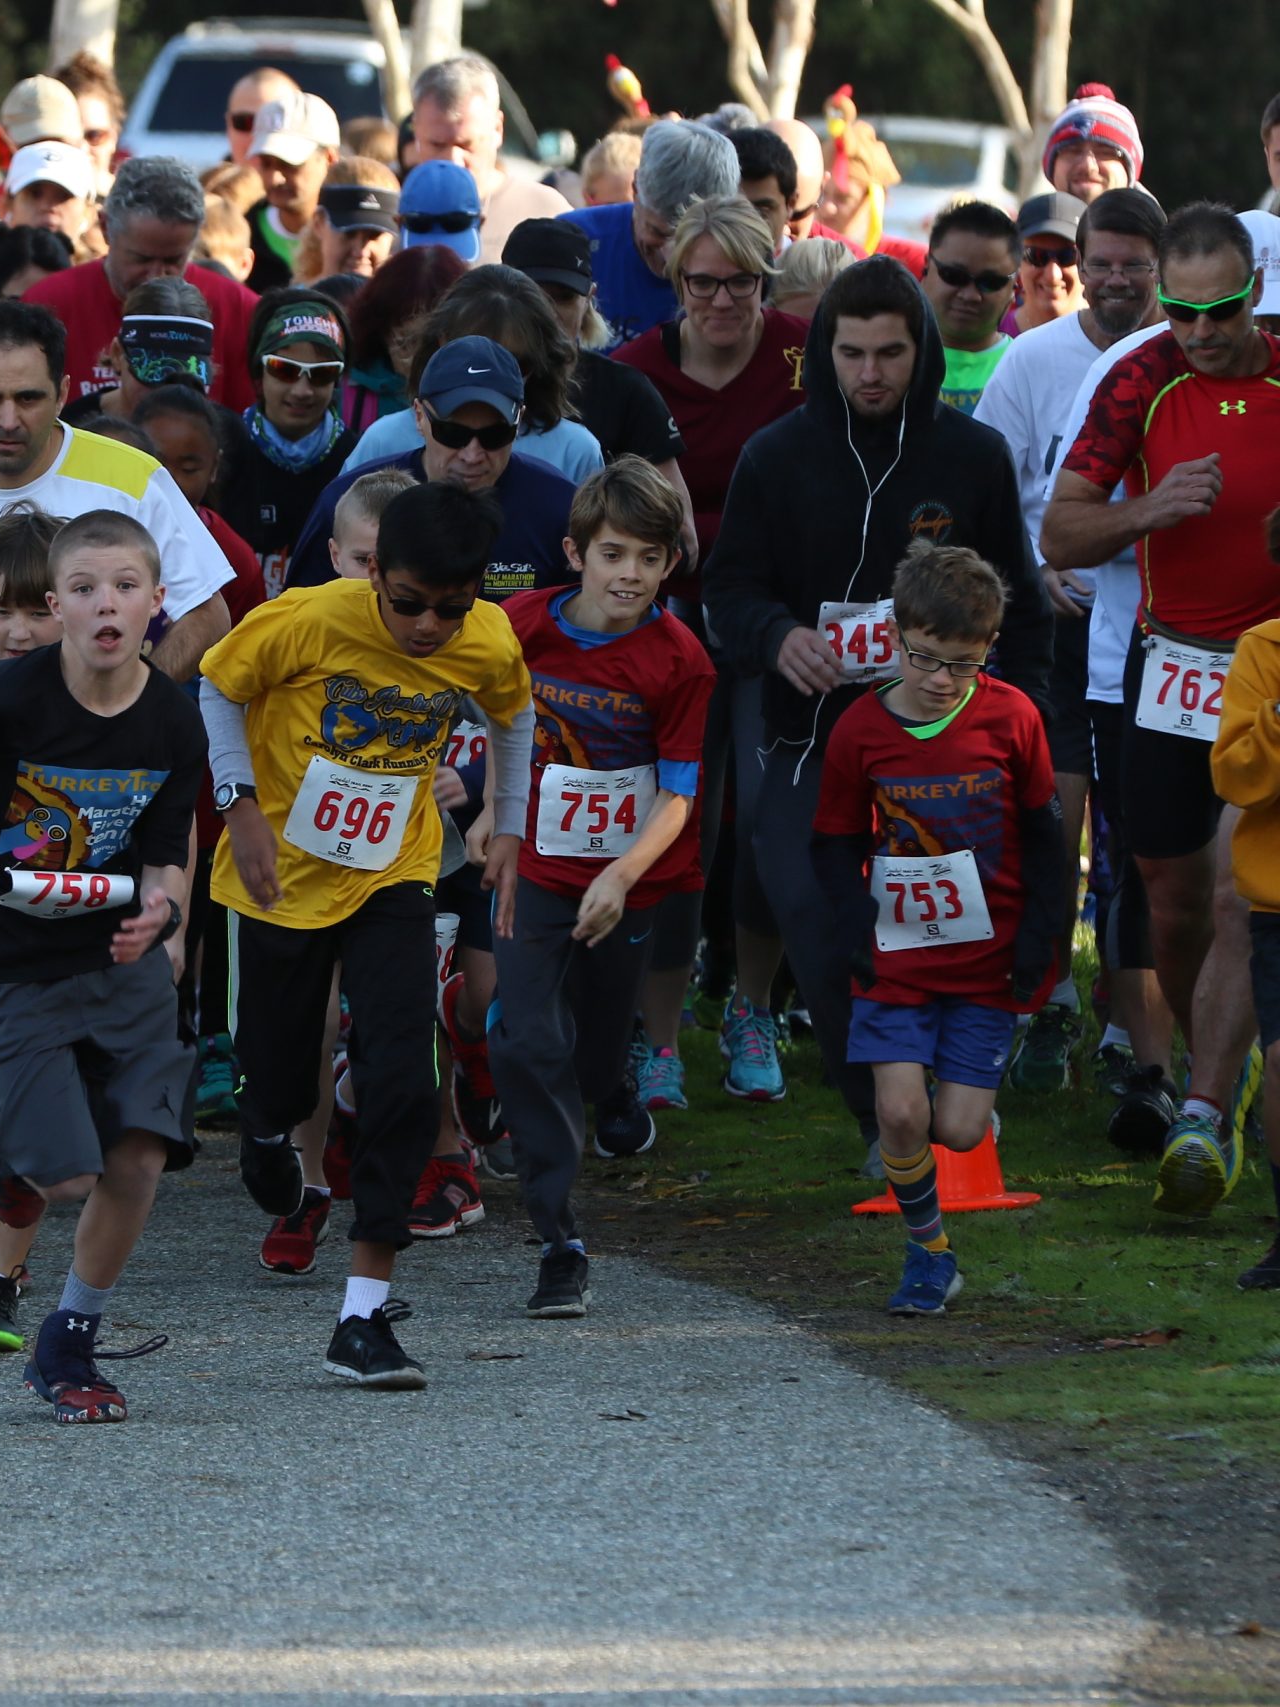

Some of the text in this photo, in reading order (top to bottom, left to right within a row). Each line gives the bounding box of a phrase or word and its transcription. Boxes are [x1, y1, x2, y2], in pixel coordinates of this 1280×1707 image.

[825, 623, 893, 664] 345
[1157, 662, 1226, 716] 762
[304, 735, 348, 762] Carolyn
[350, 753, 381, 769] Clark
[91, 819, 124, 833] Five
[313, 791, 396, 845] 696
[561, 792, 636, 834] 754
[28, 872, 111, 908] 758
[886, 879, 963, 923] 753
